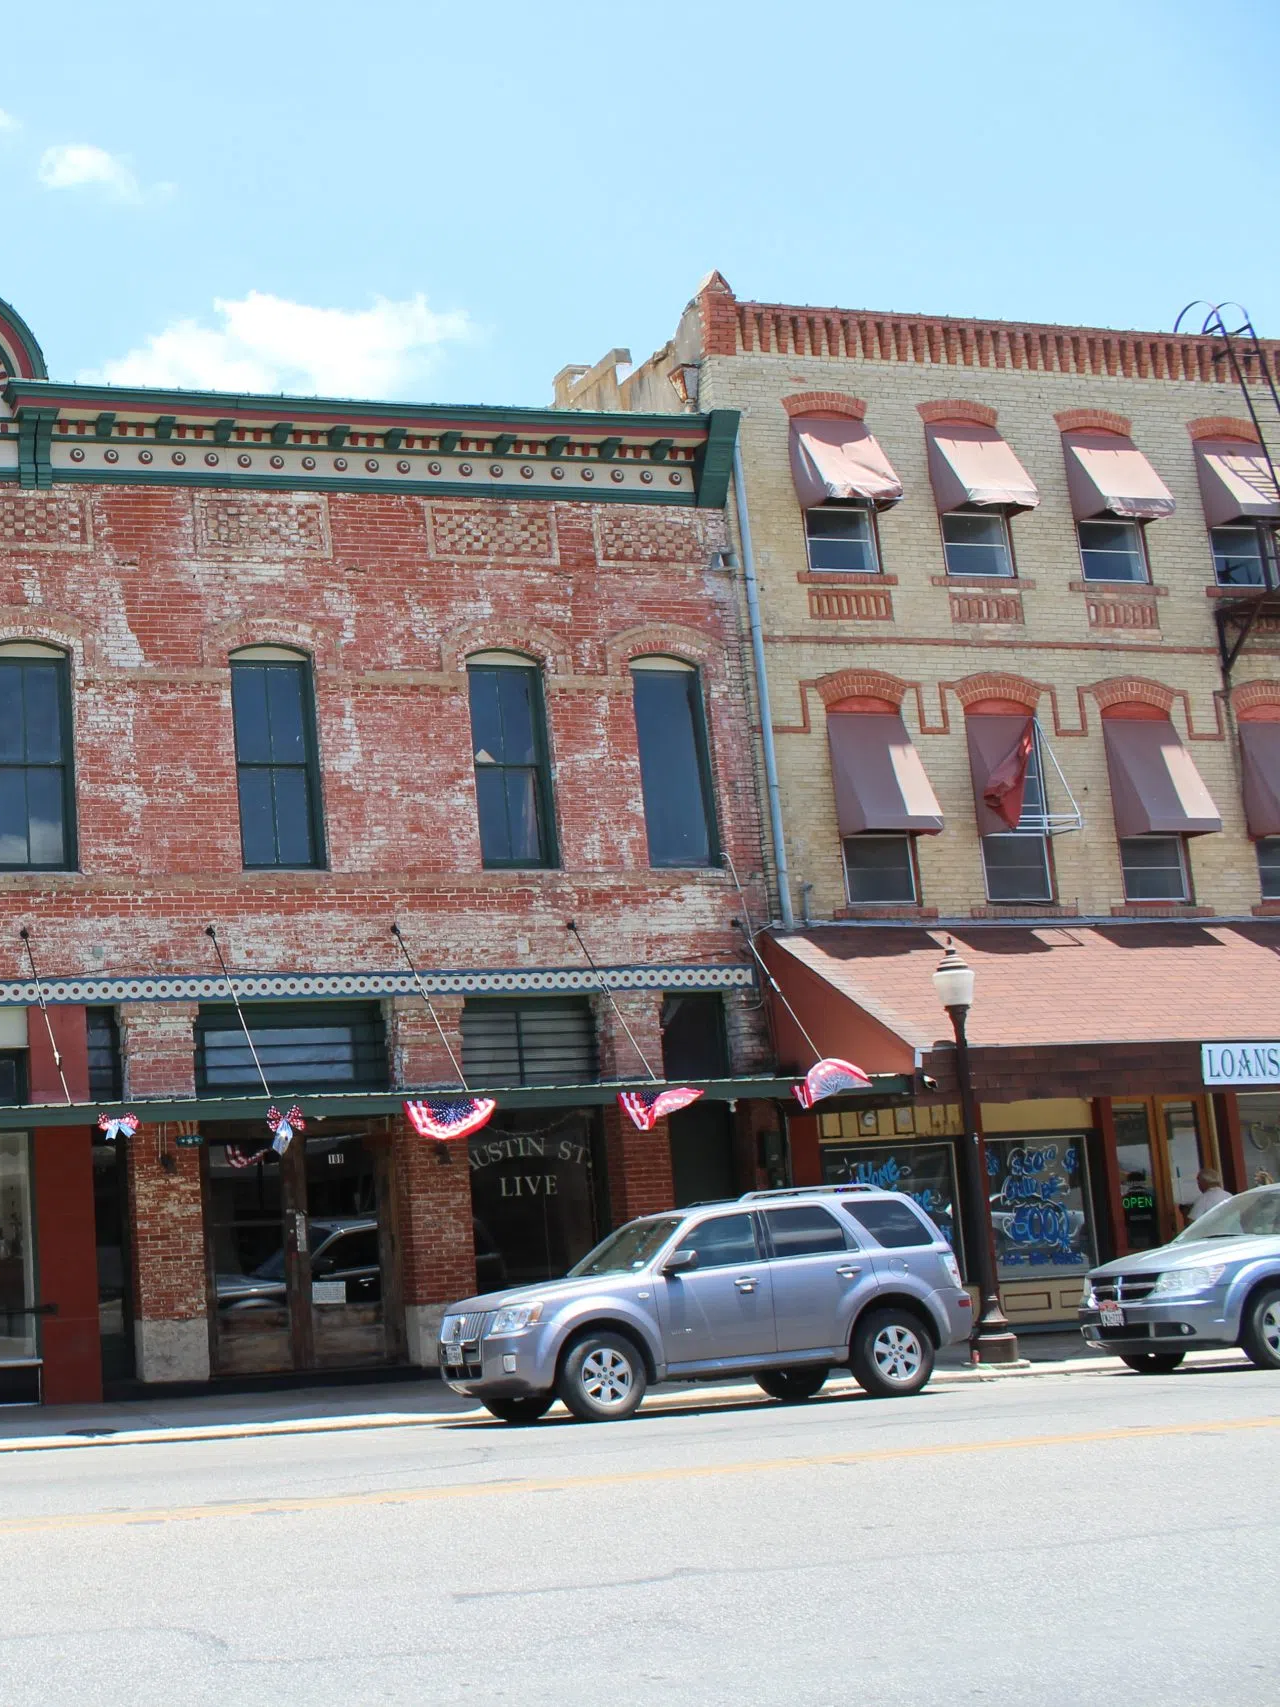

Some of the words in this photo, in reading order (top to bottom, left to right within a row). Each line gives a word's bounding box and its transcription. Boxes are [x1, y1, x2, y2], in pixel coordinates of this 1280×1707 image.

[1207, 1047, 1280, 1079] LOANS
[499, 1174, 558, 1197] LIVE
[1122, 1196, 1153, 1209] OPEN
